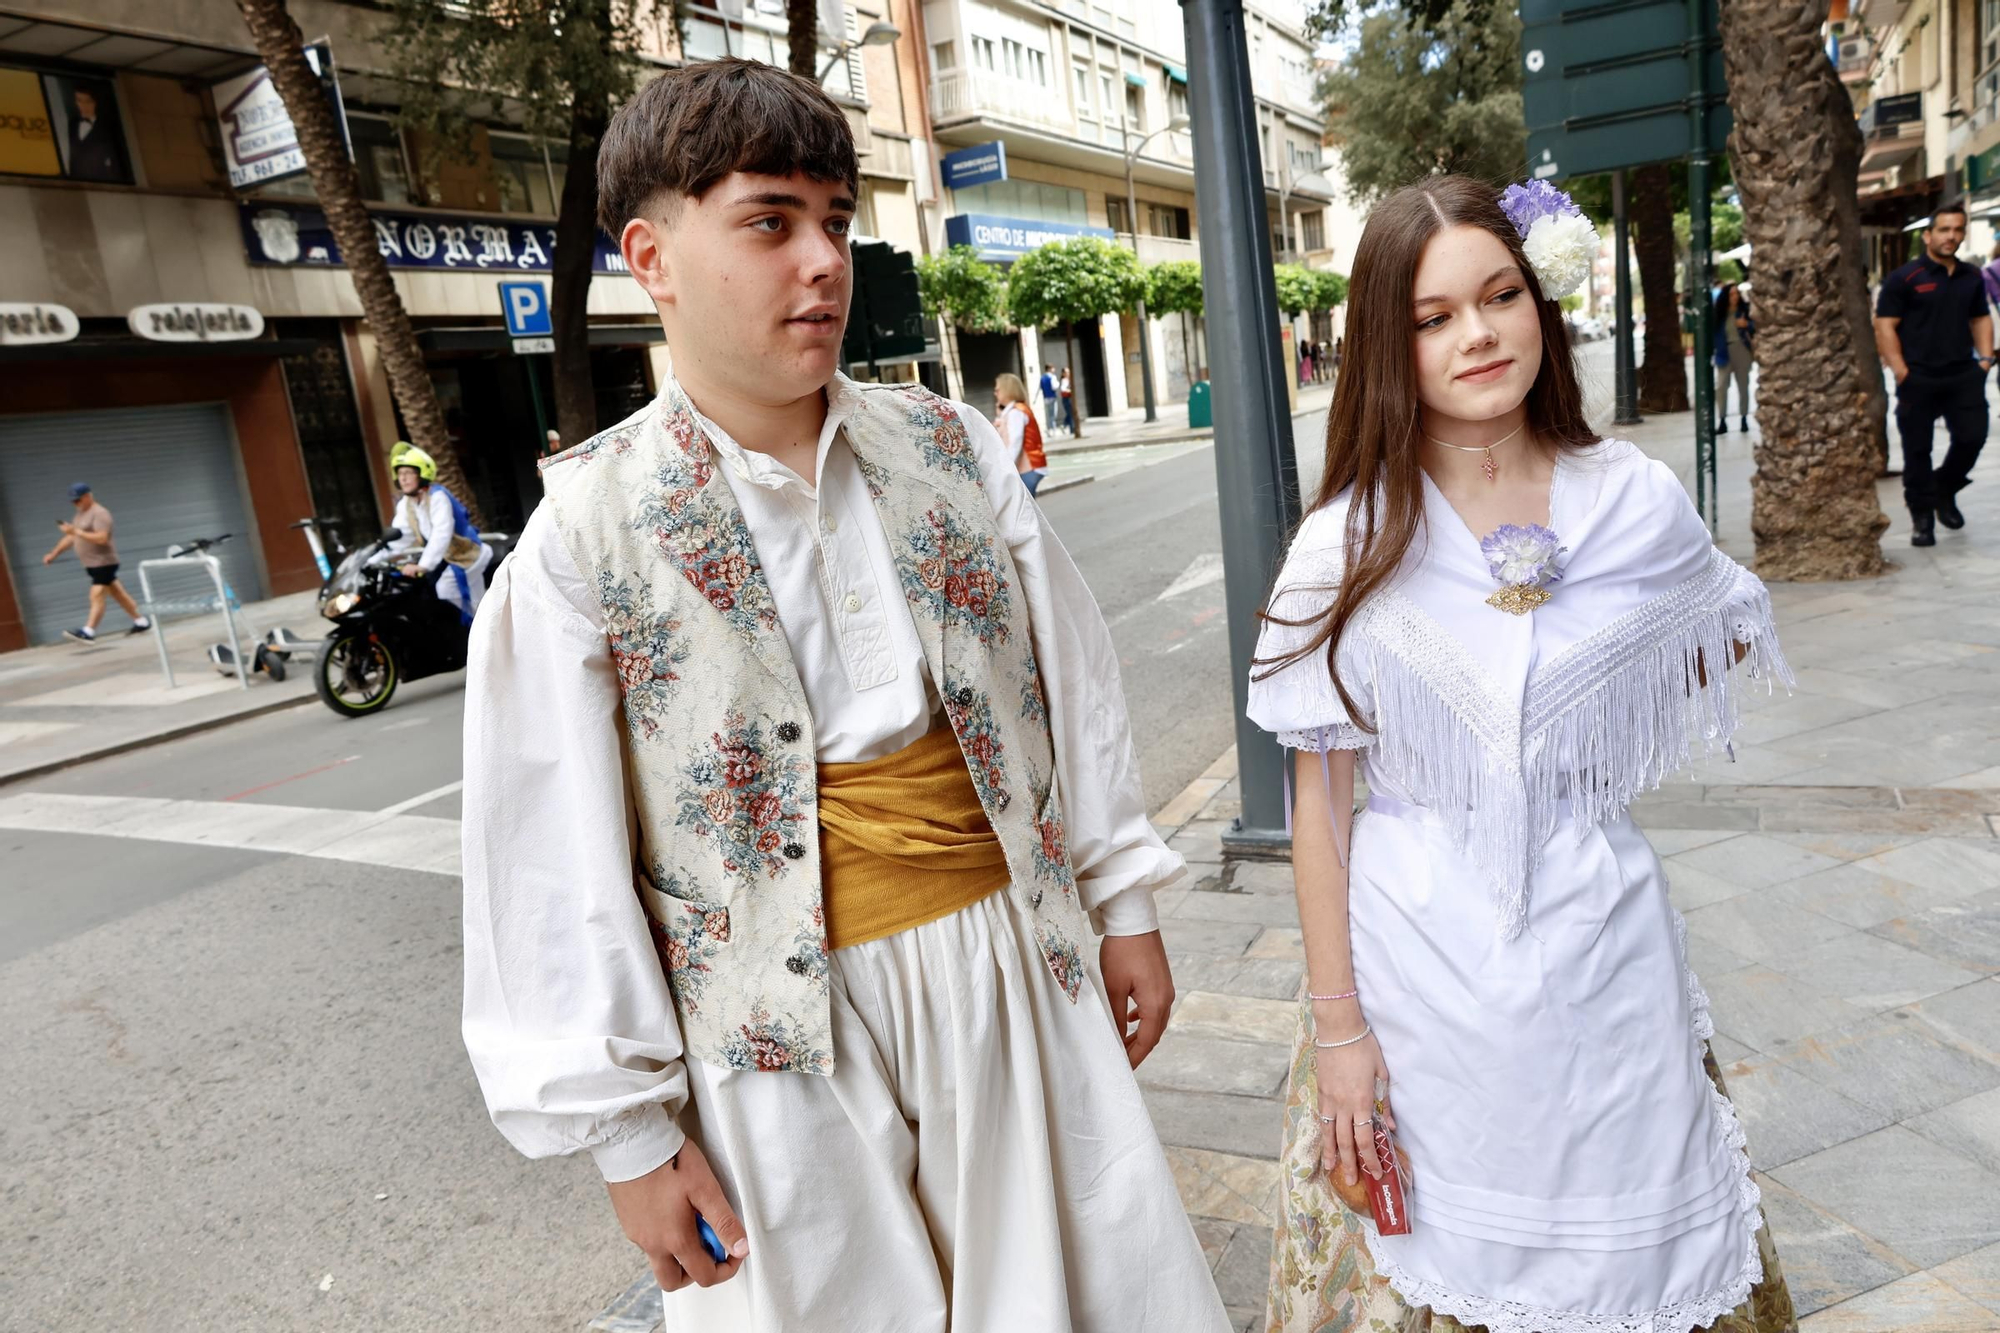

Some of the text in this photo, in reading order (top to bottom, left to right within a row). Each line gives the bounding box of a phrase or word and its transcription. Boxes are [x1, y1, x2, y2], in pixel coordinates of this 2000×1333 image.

[371, 217, 557, 269] NORMA
[974, 225, 1012, 246] CENTRO
[1012, 229, 1025, 247] DE
[509, 287, 540, 331] P
